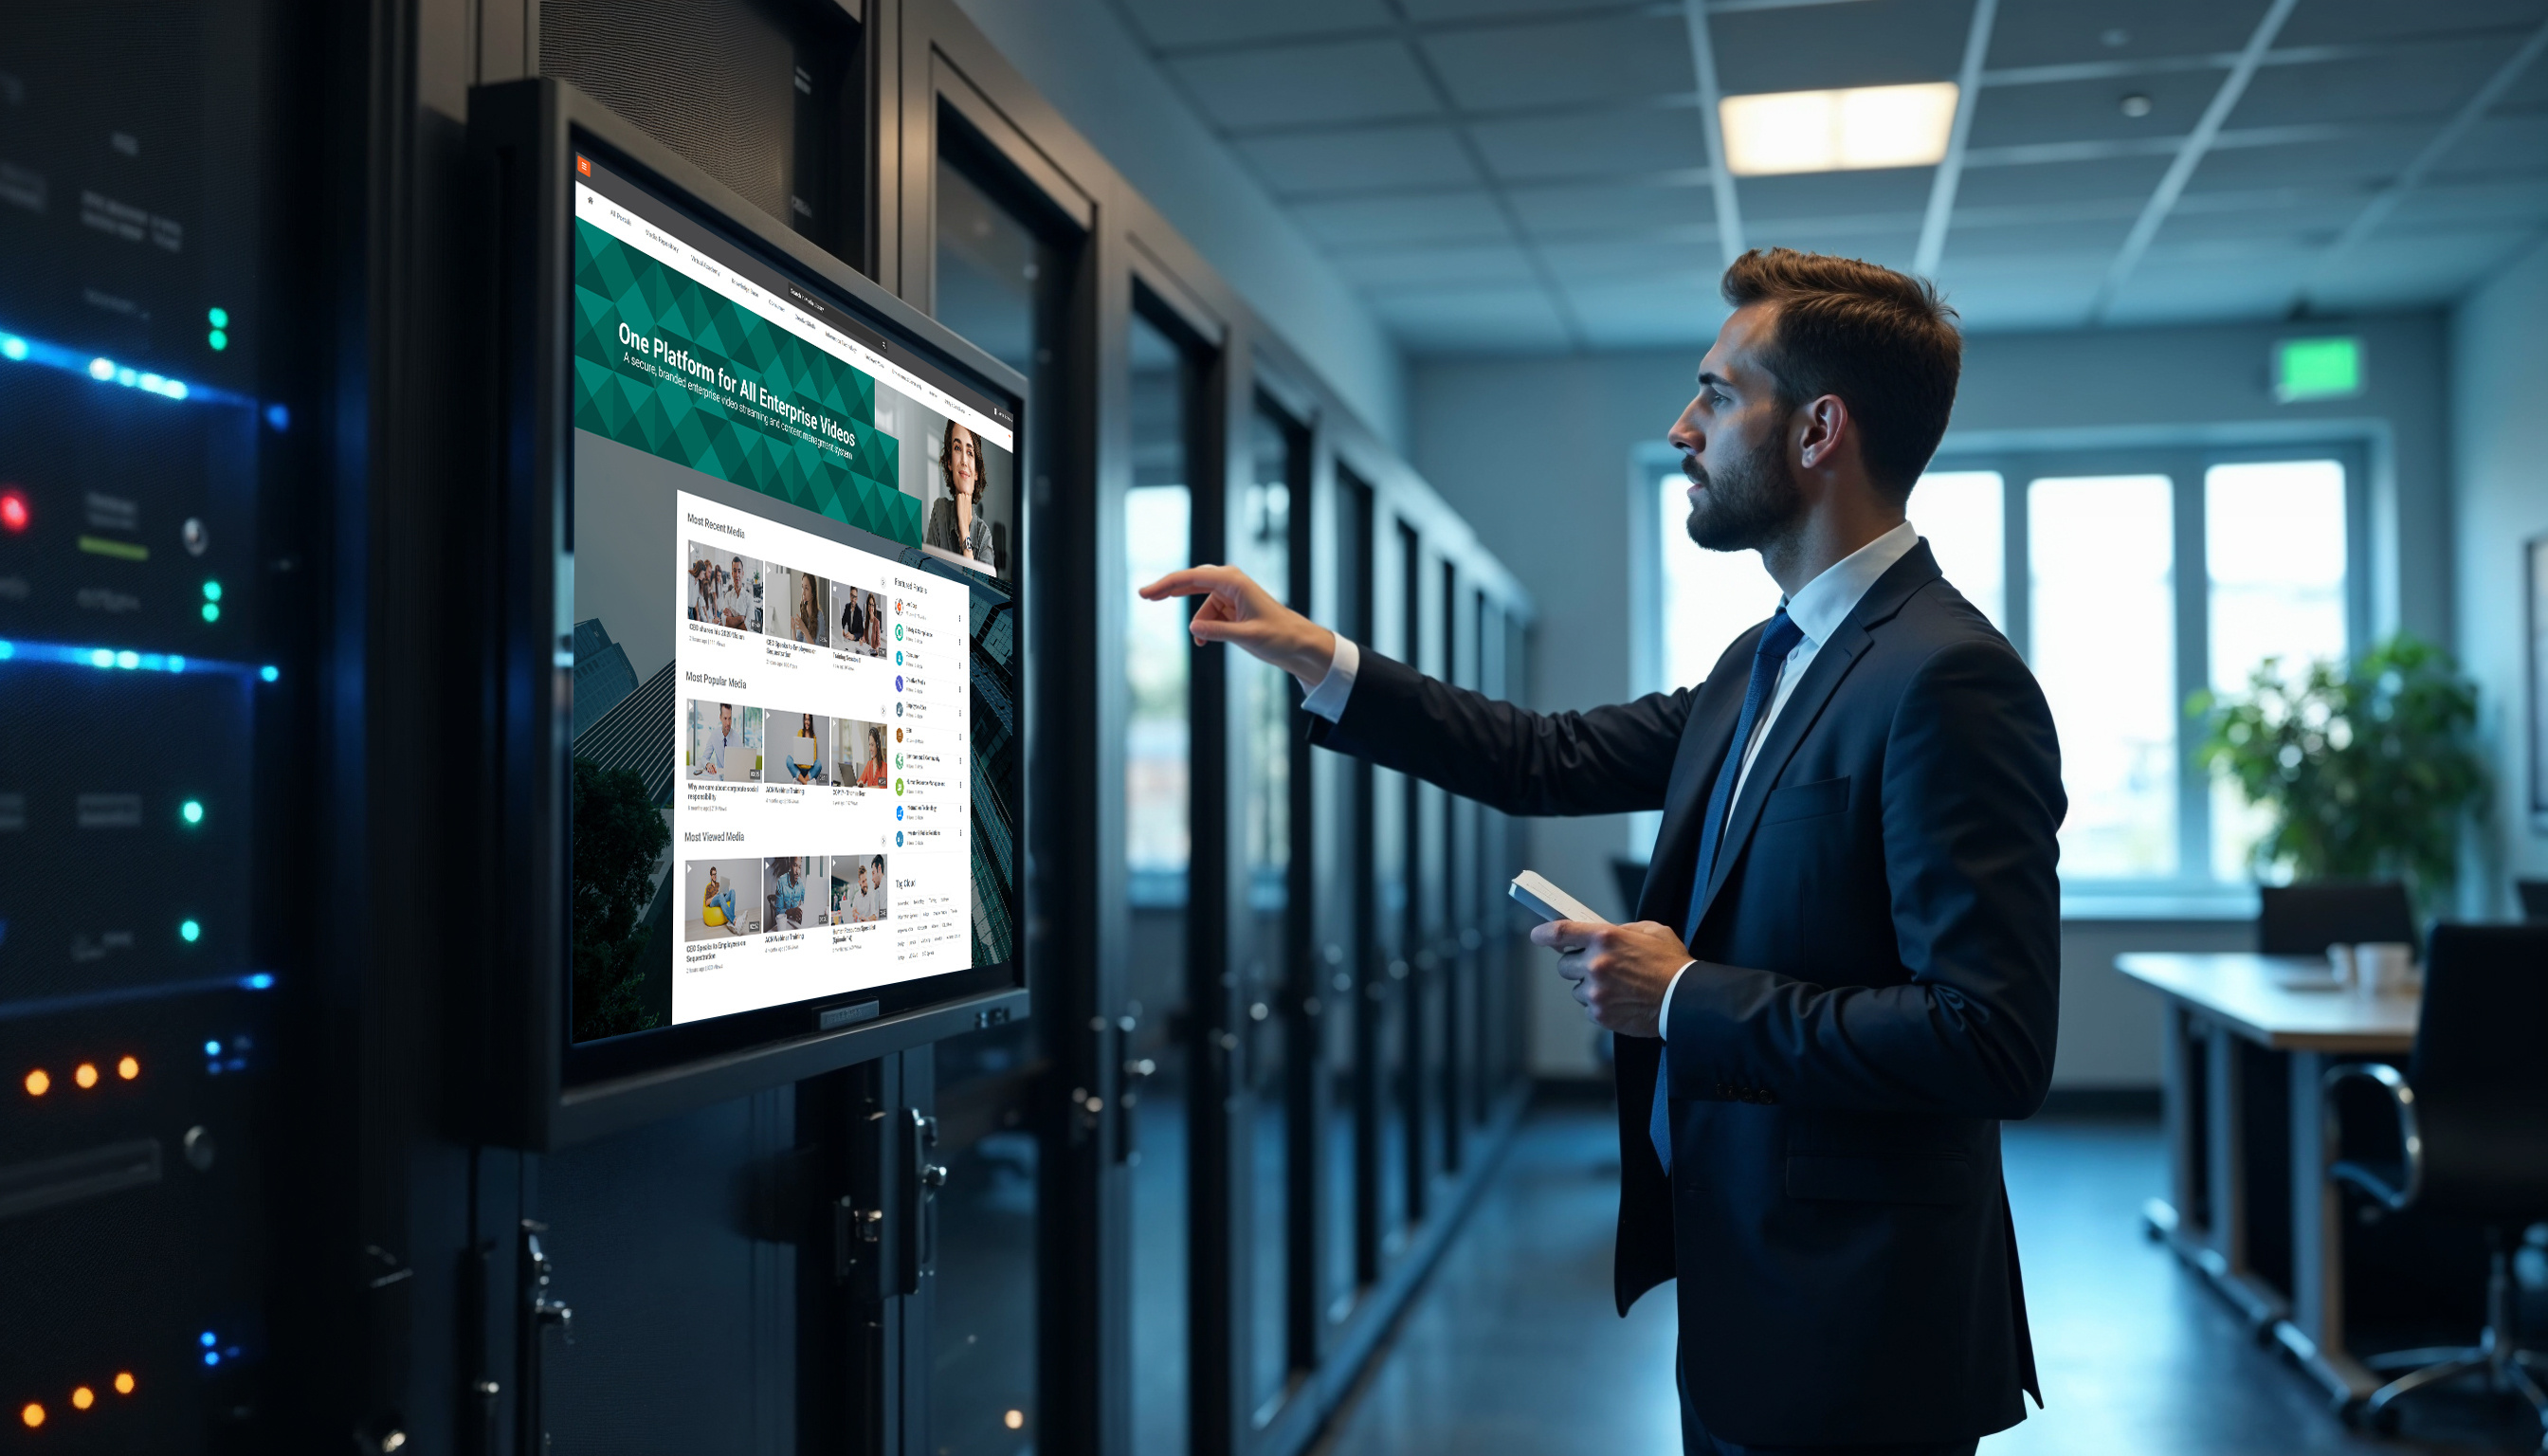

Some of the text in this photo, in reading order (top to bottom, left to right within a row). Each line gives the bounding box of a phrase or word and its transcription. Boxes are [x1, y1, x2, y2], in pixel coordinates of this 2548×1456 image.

[619, 323, 855, 446] One Platform for All Enterprise Videos
[624, 352, 629, 363] A
[631, 357, 657, 376] secure,
[659, 366, 685, 387] branded
[688, 382, 720, 402] enterprise
[721, 397, 737, 410] video
[739, 405, 768, 426] streaming
[771, 418, 779, 428] and
[781, 423, 802, 438] content
[834, 446, 852, 459] system
[688, 513, 744, 538] Most Recent Media
[895, 578, 912, 590] Featured
[700, 626, 713, 634] shares
[686, 671, 746, 689] Most Popular Media
[688, 783, 697, 792] Why
[685, 831, 744, 842] Most Viewed Media
[719, 941, 739, 950] Employees
[686, 953, 716, 962] Sequestration
